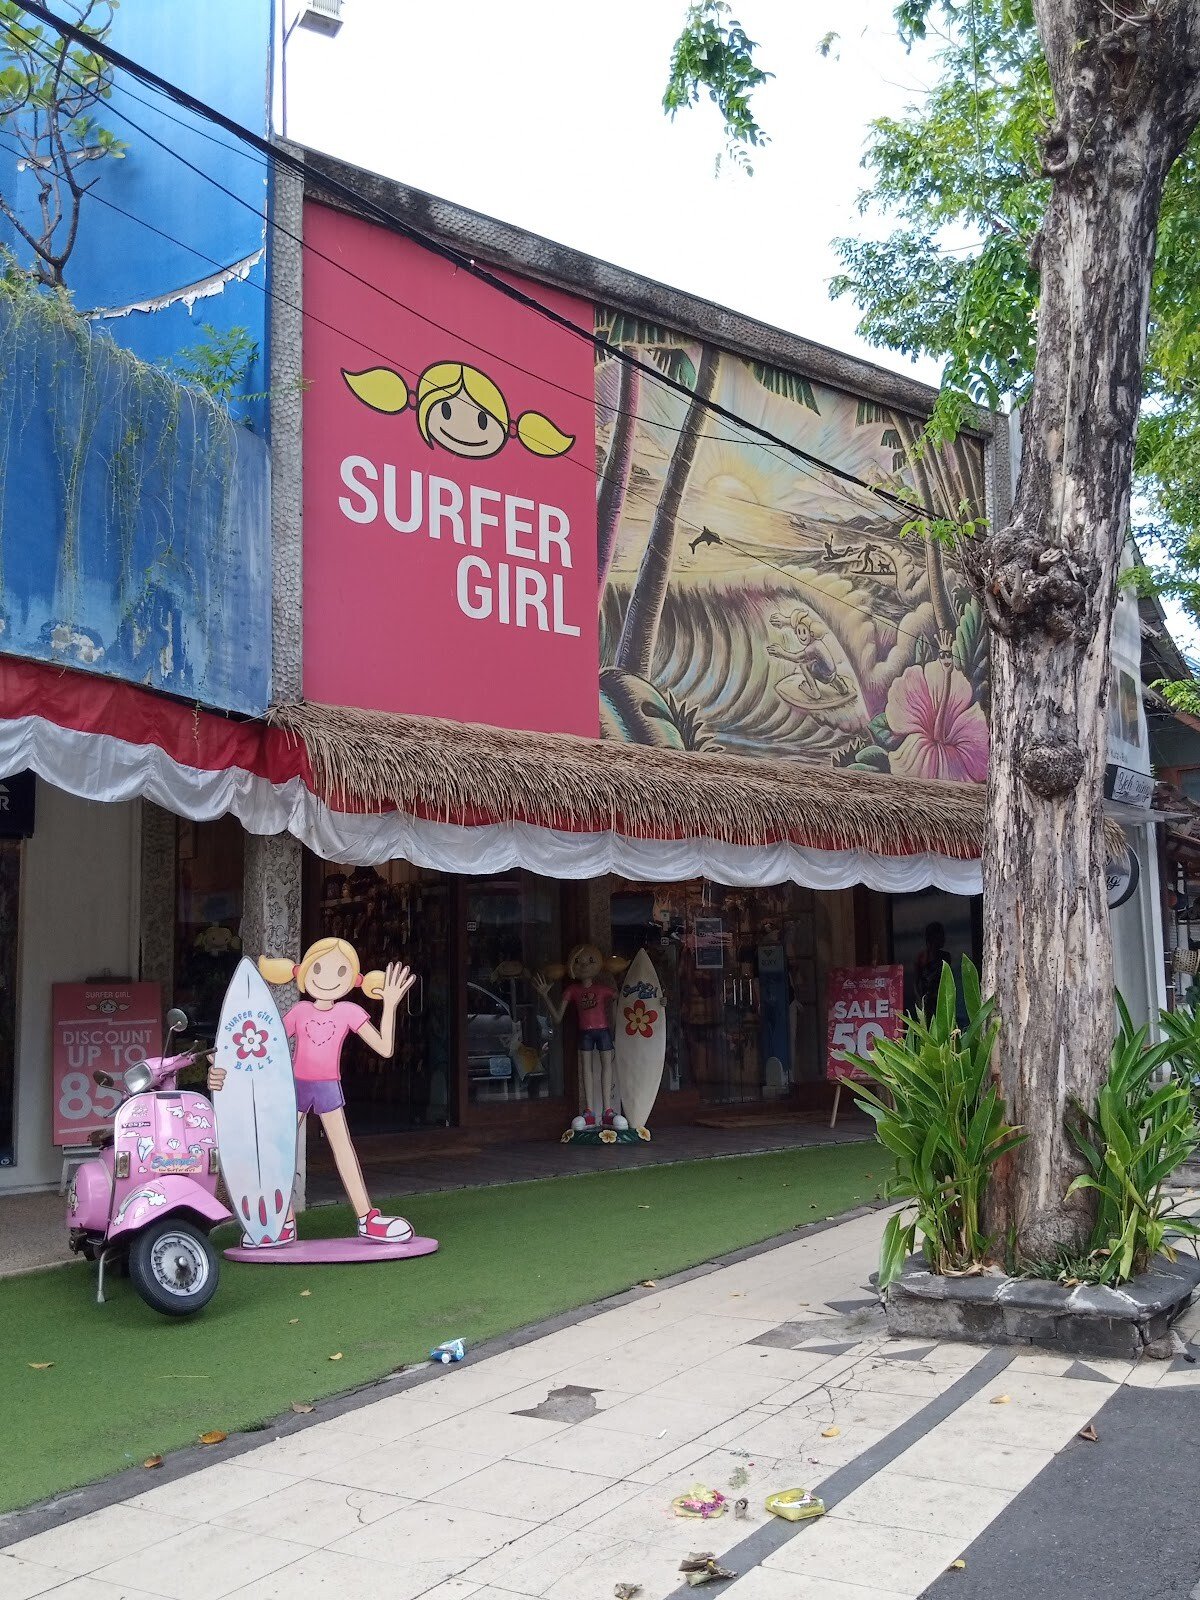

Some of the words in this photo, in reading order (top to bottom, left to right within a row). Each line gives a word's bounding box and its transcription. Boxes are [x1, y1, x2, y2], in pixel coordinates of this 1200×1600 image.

[338, 455, 573, 568] SURFER
[456, 555, 581, 637] GIRL
[85, 991, 114, 999] SURFER
[834, 999, 890, 1019] SALE
[62, 1030, 152, 1045] DISCOUNT
[829, 1022, 885, 1061] 50
[68, 1045, 102, 1068] UP
[109, 1044, 148, 1066] TO
[234, 1055, 274, 1072] BALI
[59, 1072, 123, 1119] 85
